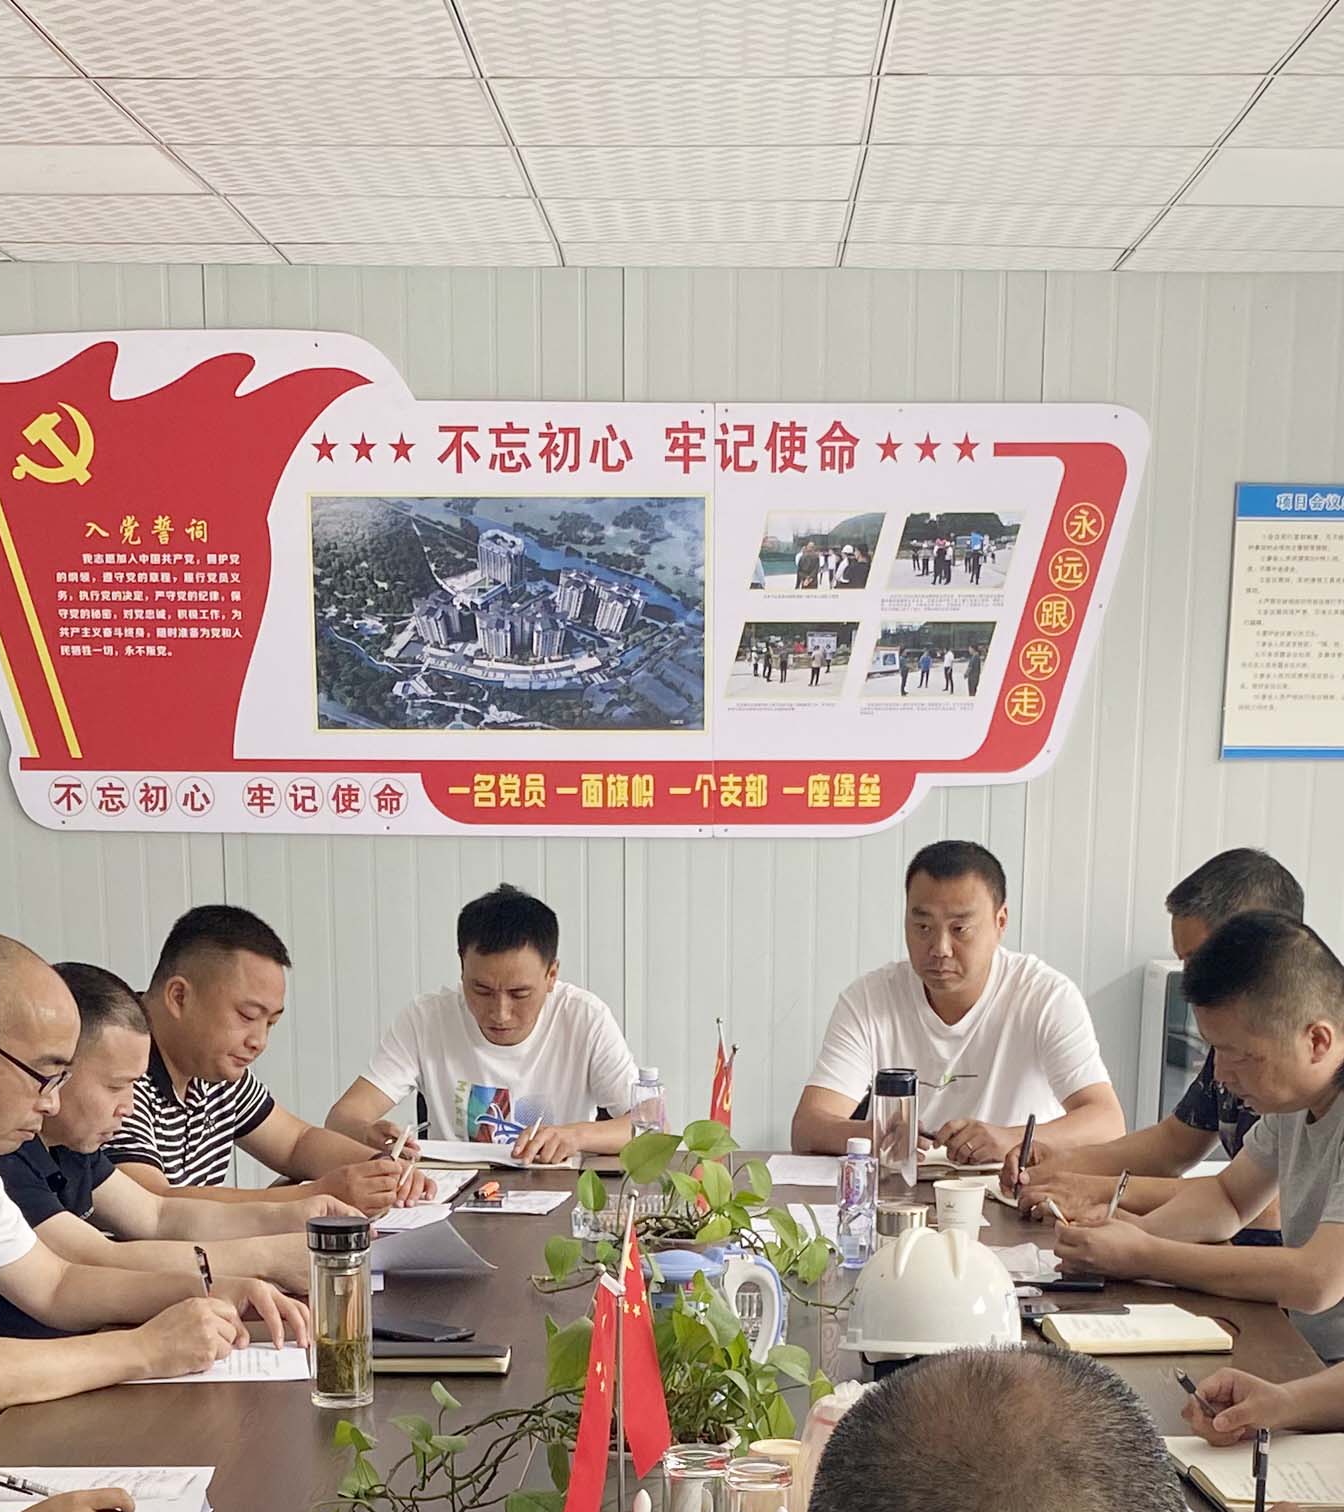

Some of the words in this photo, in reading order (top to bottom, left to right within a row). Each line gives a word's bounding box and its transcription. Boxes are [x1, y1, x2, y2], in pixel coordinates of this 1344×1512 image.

[437, 421, 634, 475] 不忘初心
[663, 419, 862, 475] 牢记使命
[85, 514, 208, 545] 入党誓词
[1007, 507, 1102, 722] 永远跟党走
[54, 779, 213, 813] 不忘初心
[244, 781, 407, 815] 牢记使命
[447, 774, 547, 809] 一名党员
[556, 774, 655, 810] 一面旗帜
[668, 774, 769, 809] 一个支部
[782, 774, 882, 809] 一座堡垒
